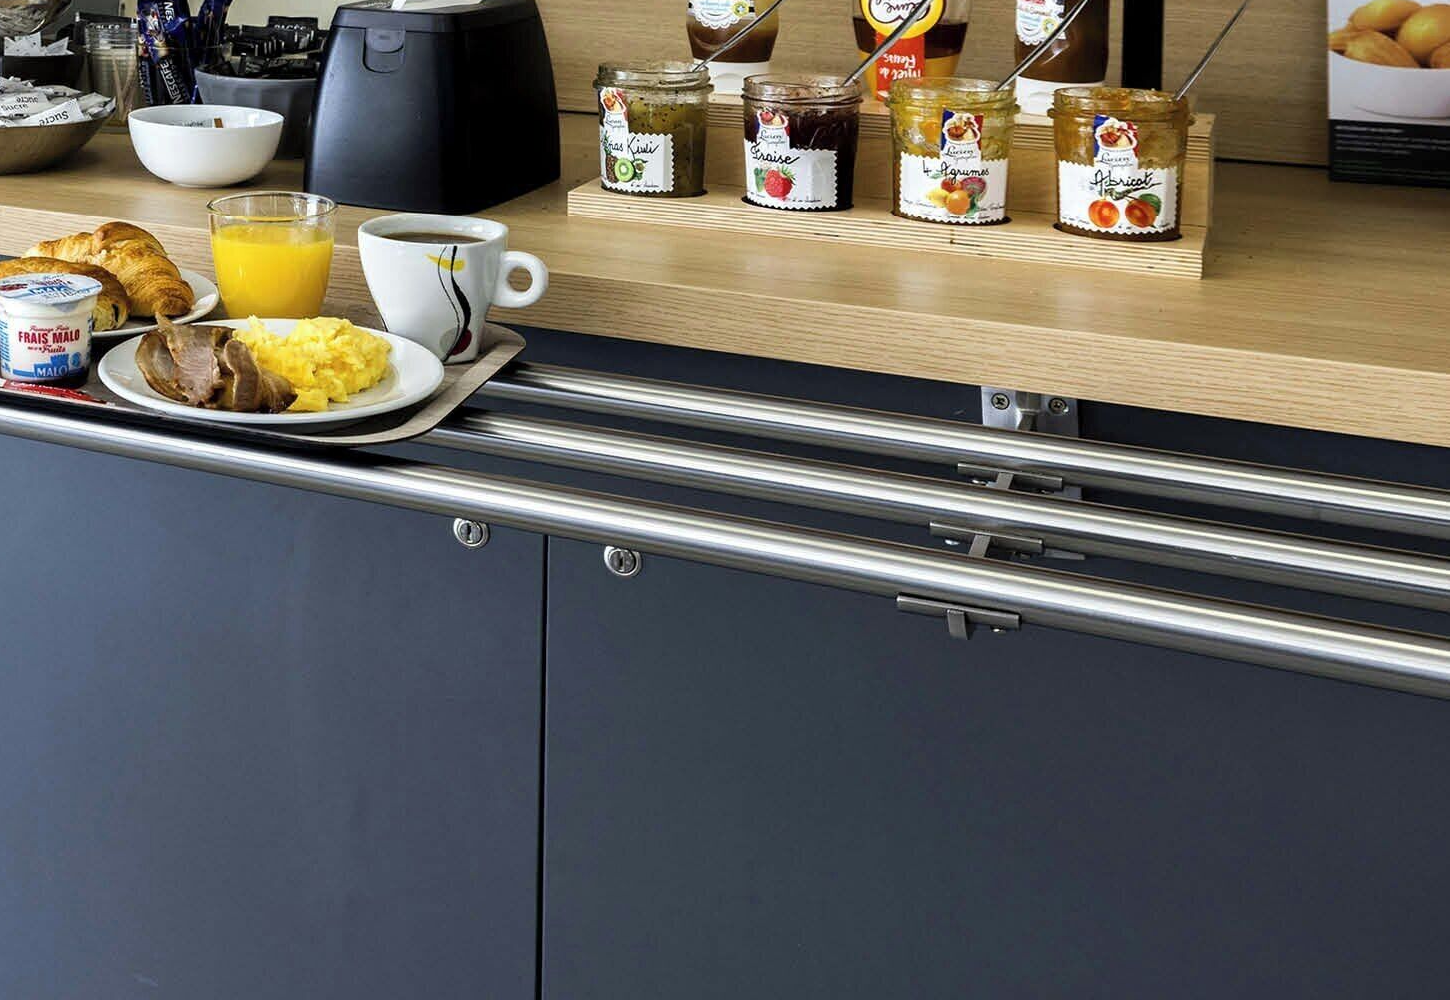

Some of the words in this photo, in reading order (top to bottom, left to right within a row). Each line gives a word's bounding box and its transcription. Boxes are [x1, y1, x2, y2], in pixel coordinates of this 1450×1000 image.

[883, 2, 920, 18] une
[39, 110, 69, 126] Sucre
[750, 142, 800, 164] Fraise
[936, 161, 990, 185] Agrumes
[1090, 169, 1154, 191] Abricot
[18, 331, 49, 345] FRAIS
[53, 329, 80, 344] MALO
[37, 366, 67, 377] MALO
